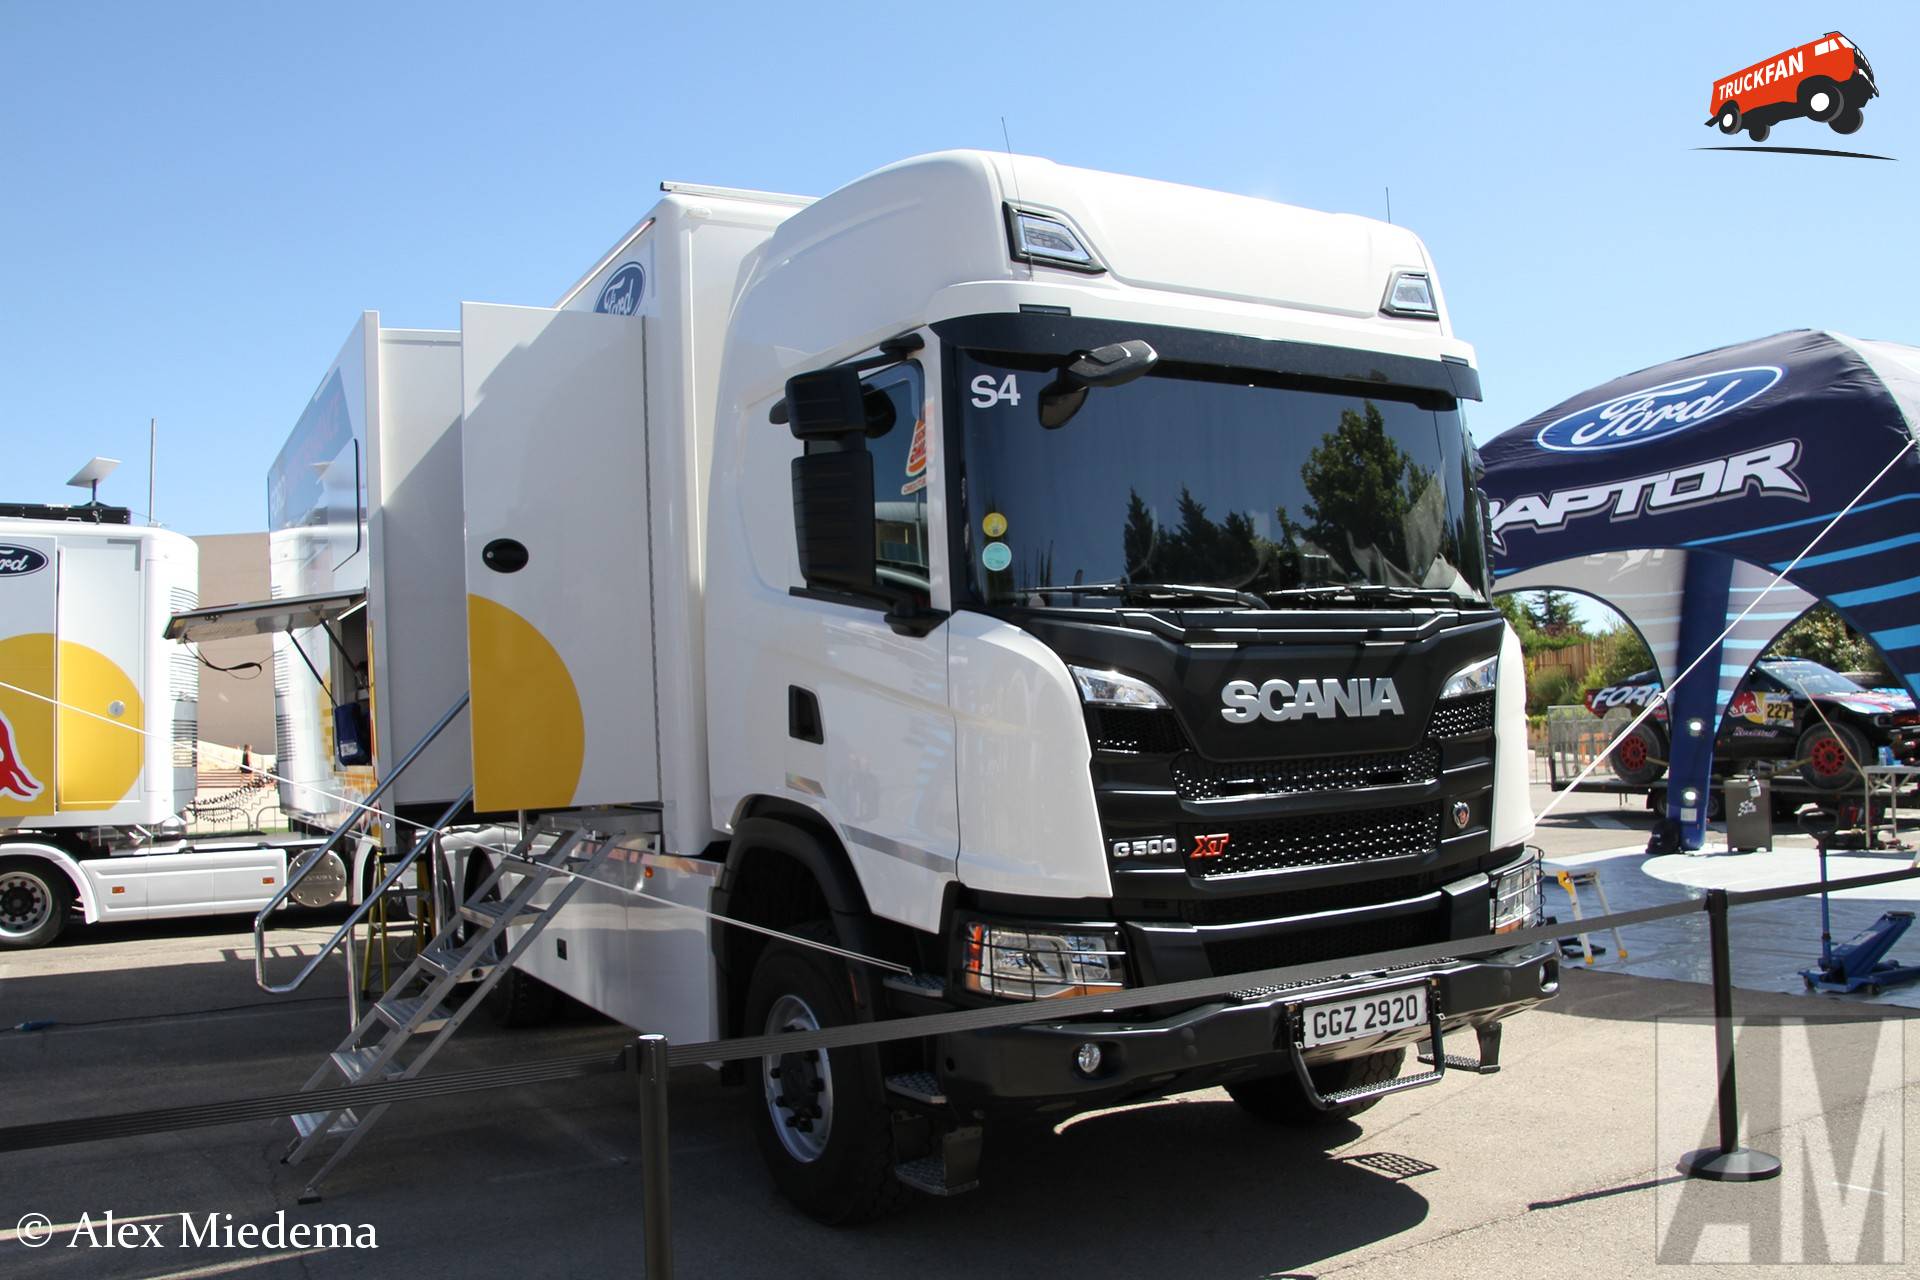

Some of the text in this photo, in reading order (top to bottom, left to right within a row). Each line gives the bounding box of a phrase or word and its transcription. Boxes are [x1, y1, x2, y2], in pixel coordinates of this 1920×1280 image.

[971, 374, 1021, 408] S4
[1571, 379, 1743, 445] Ford
[1220, 677, 1404, 724] SCANIA
[1113, 833, 1229, 858] G 500 XT
[1313, 994, 1418, 1039] GGZ 2920
